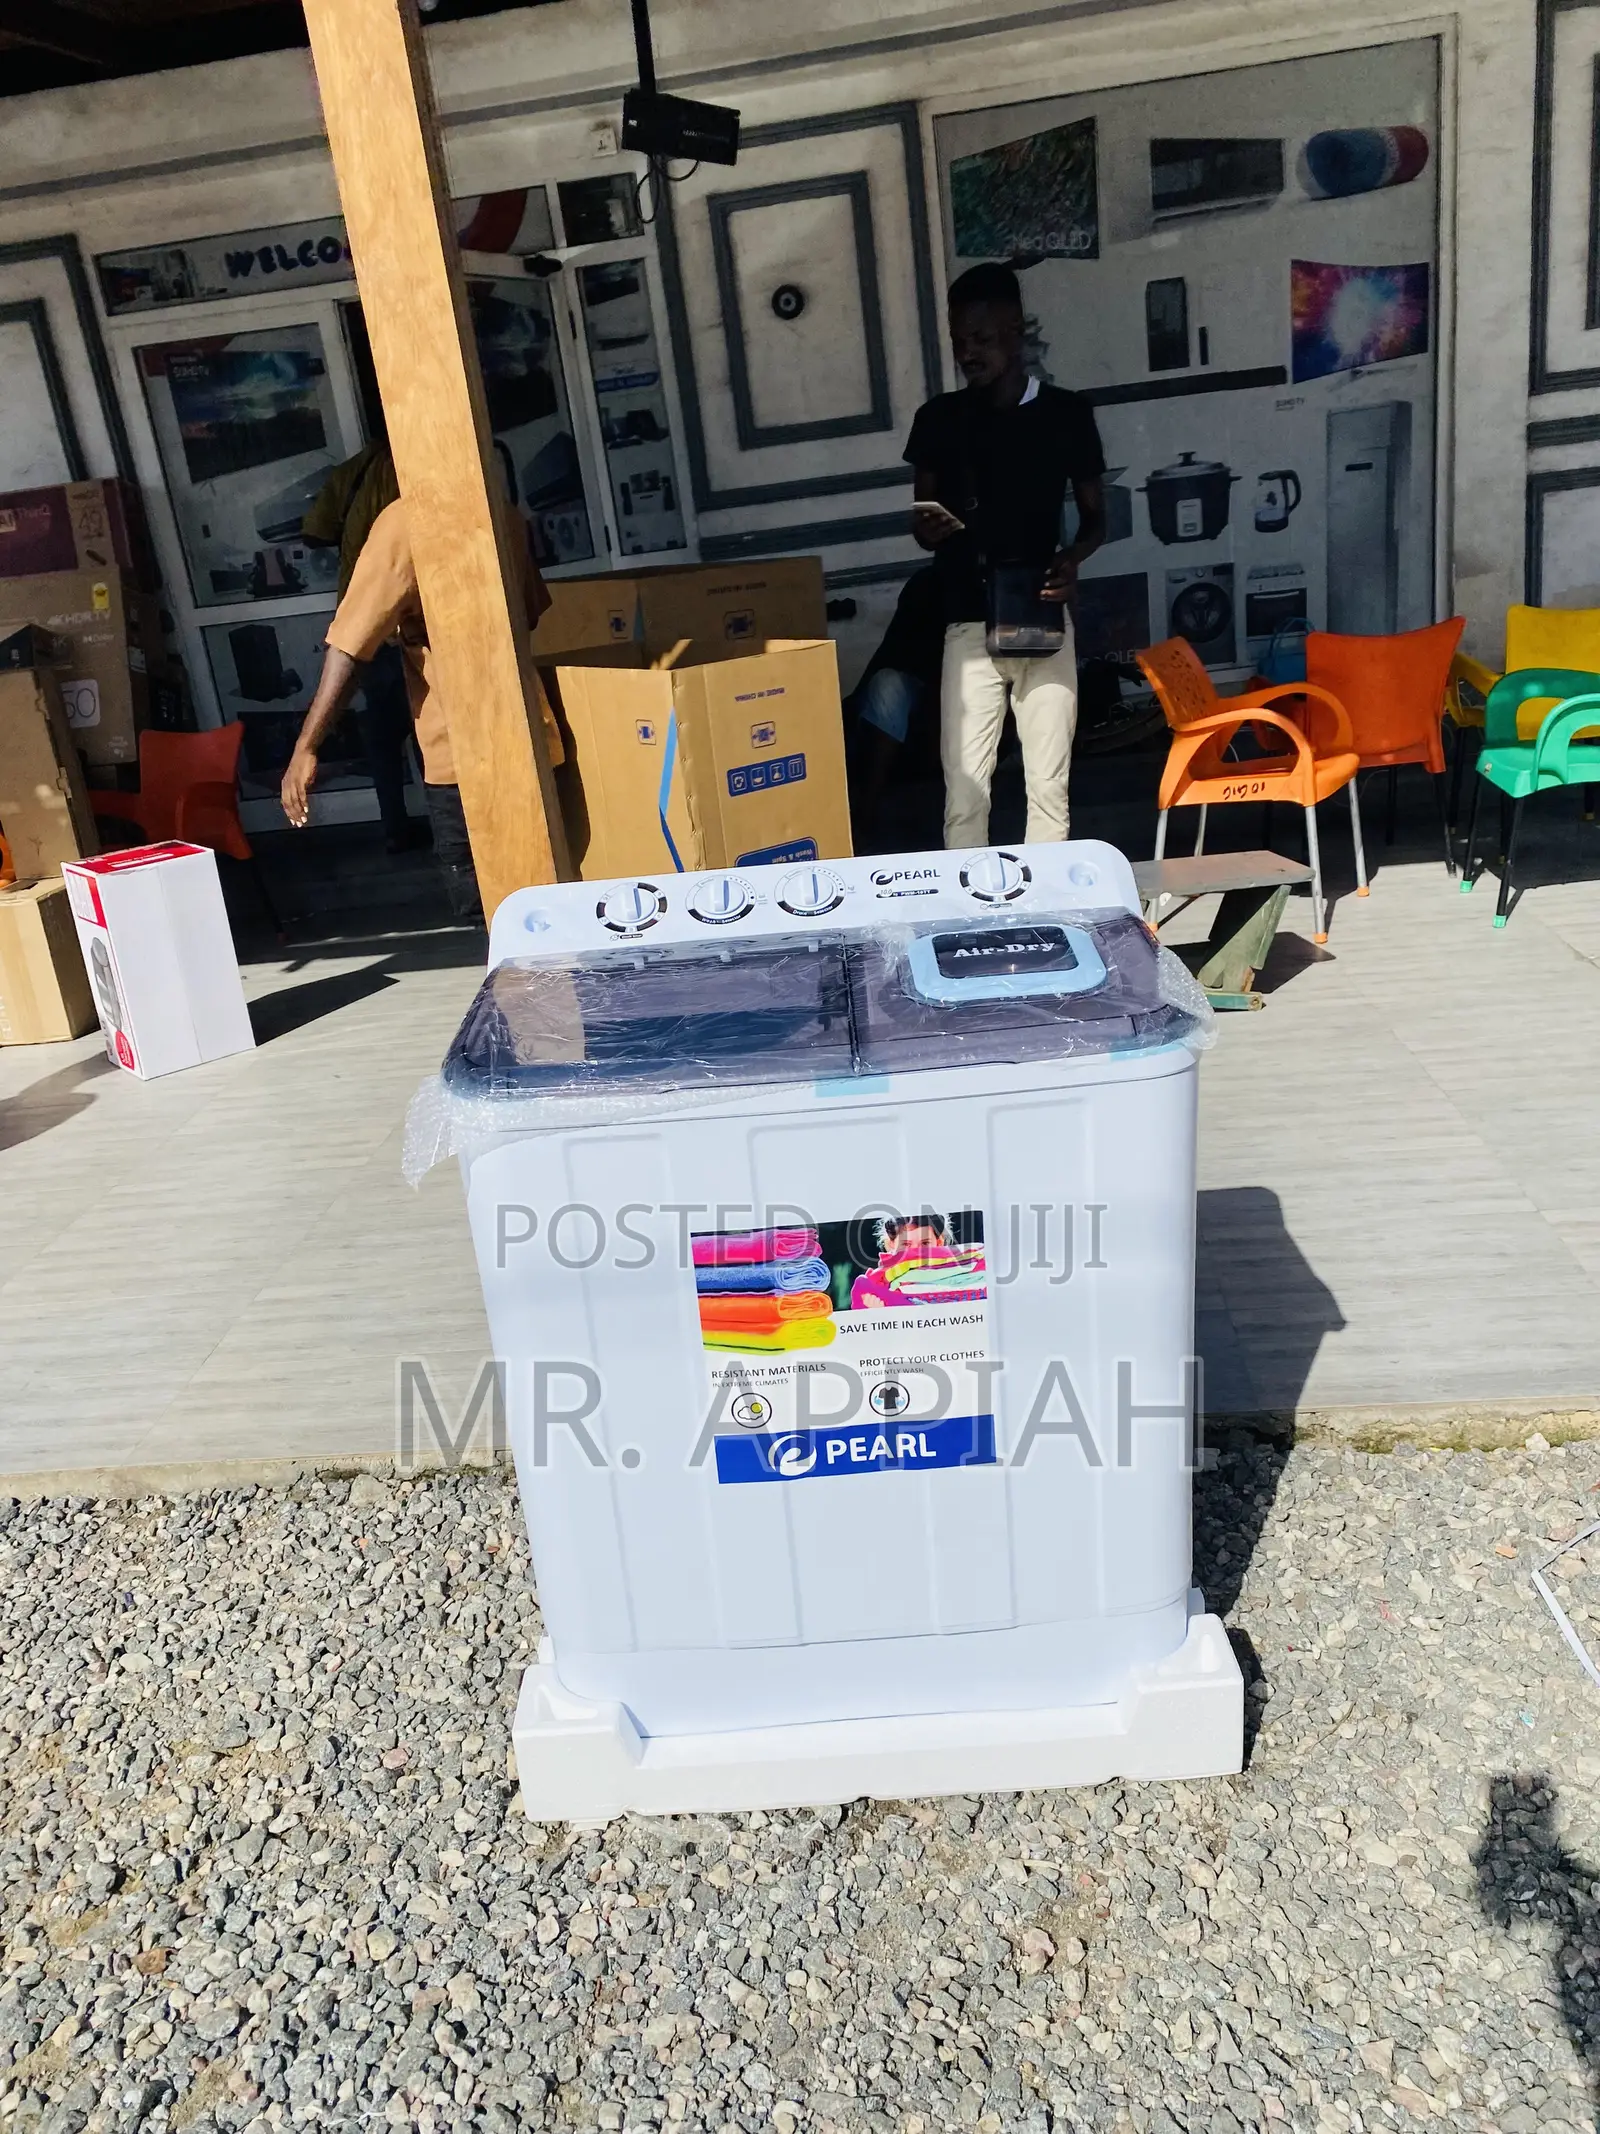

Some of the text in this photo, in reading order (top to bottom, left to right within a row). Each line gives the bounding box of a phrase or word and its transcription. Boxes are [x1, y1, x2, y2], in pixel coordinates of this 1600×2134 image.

[224, 236, 351, 279] WELCO
[894, 868, 941, 881] PEARL
[953, 942, 1055, 958] Air-Dry
[839, 1313, 984, 1335] SAVE TIME IN EACH WASH
[859, 1349, 985, 1368] PROTECT YOUR CLOTHES
[711, 1363, 827, 1379] RESISTANT MATERIALS
[860, 1367, 924, 1378] EFFICIENTLY WASH
[755, 1377, 789, 1387] CLIMATES
[825, 1432, 937, 1465] PEARL
